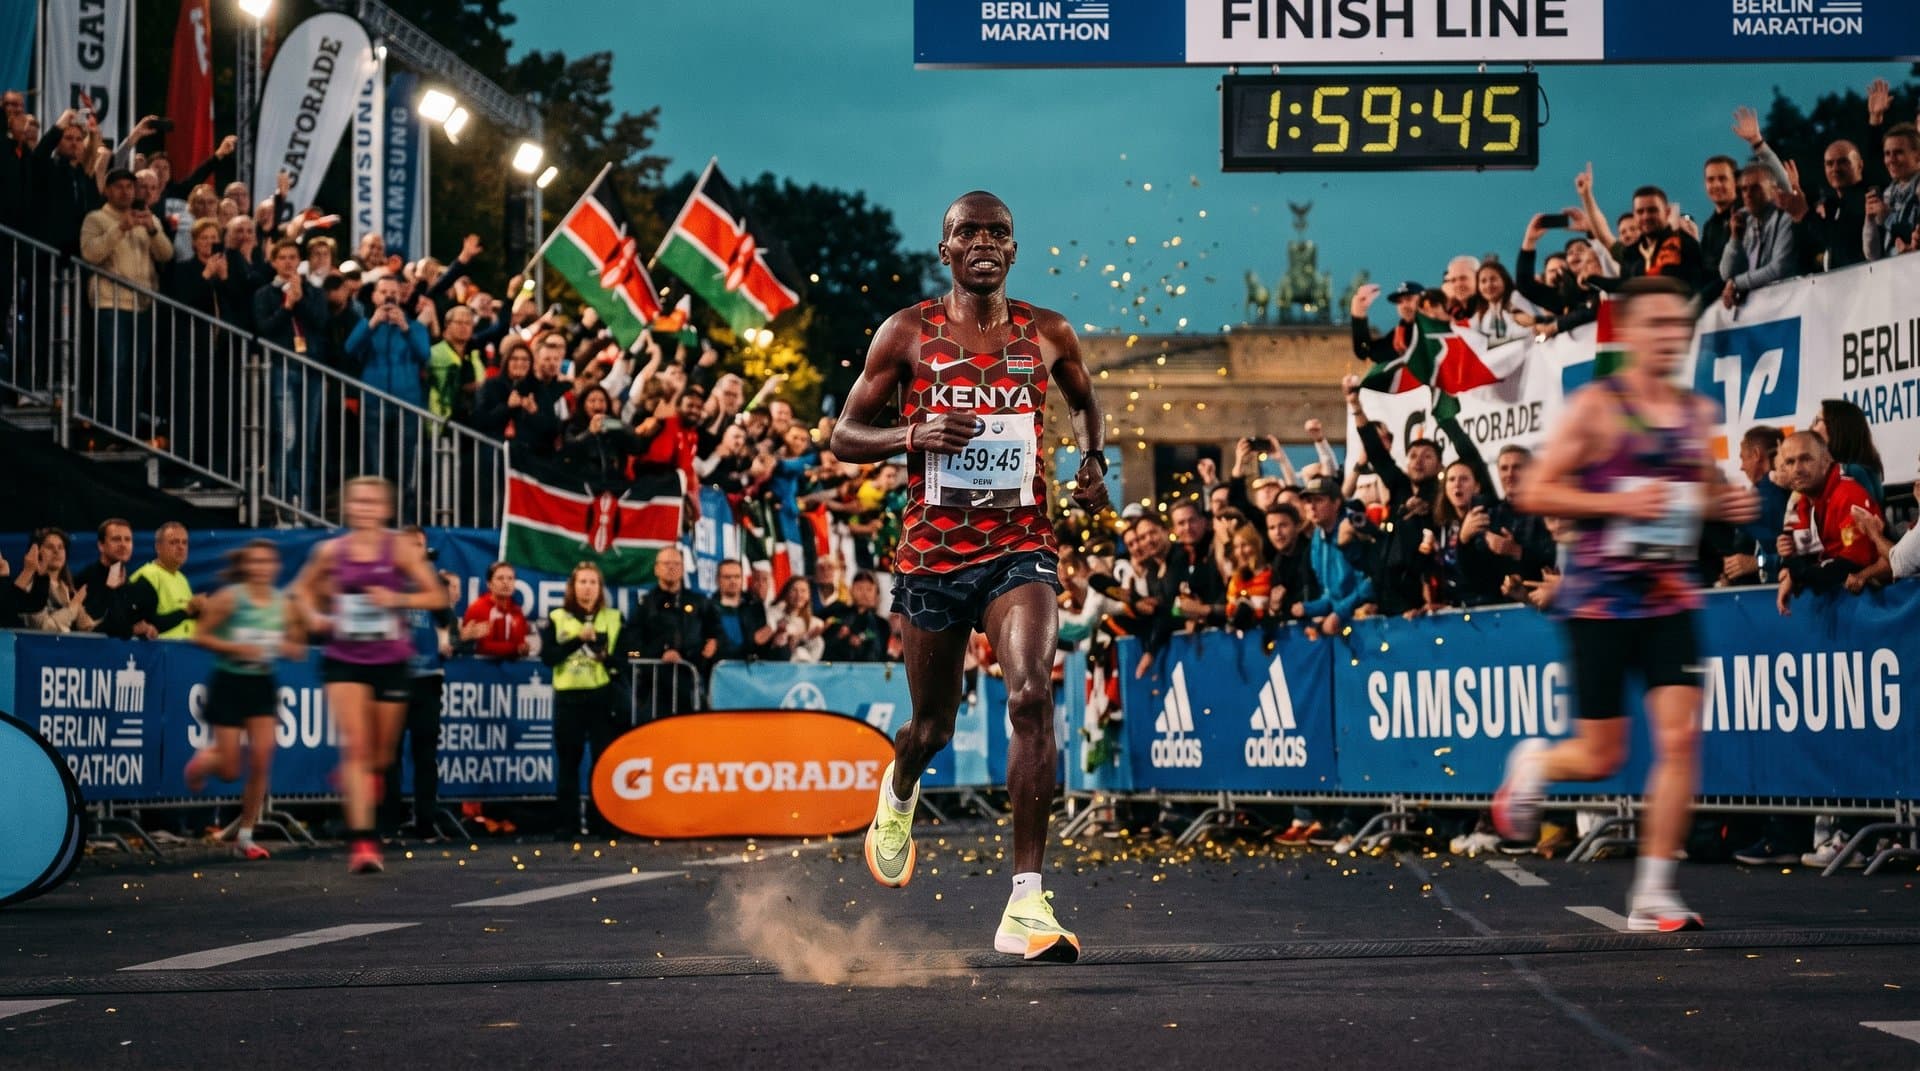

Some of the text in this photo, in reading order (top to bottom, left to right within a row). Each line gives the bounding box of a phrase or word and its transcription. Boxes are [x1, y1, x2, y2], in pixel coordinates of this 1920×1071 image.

[981, 2, 1061, 20] BERLIN
[1222, 0, 1568, 39] FINISH LINE
[1733, 0, 1813, 14] BERLIN
[981, 23, 1110, 41] MARATHON
[1733, 17, 1862, 35] MARATHON
[1267, 86, 1520, 153] 1:59:45
[386, 106, 409, 248] SAMSUNG
[1843, 315, 1920, 381] BERLI
[931, 385, 1033, 408] KENYA
[1843, 378, 1920, 424] ARAT
[1434, 401, 1542, 451] GTORADE
[946, 447, 1021, 471] 1:59:45
[41, 666, 112, 709] BERLIN
[440, 682, 512, 719] BERLIN
[1368, 662, 1570, 741] SAMSUNG
[1702, 648, 1900, 732] AMSUNG
[40, 714, 106, 747] BERLIN
[437, 723, 506, 751] BERLIN
[1245, 728, 1307, 768] adidas
[1151, 731, 1203, 768] adidas
[66, 754, 143, 786] RATHON
[436, 756, 553, 784] MARATHON
[612, 758, 879, 800] G GATORADE
